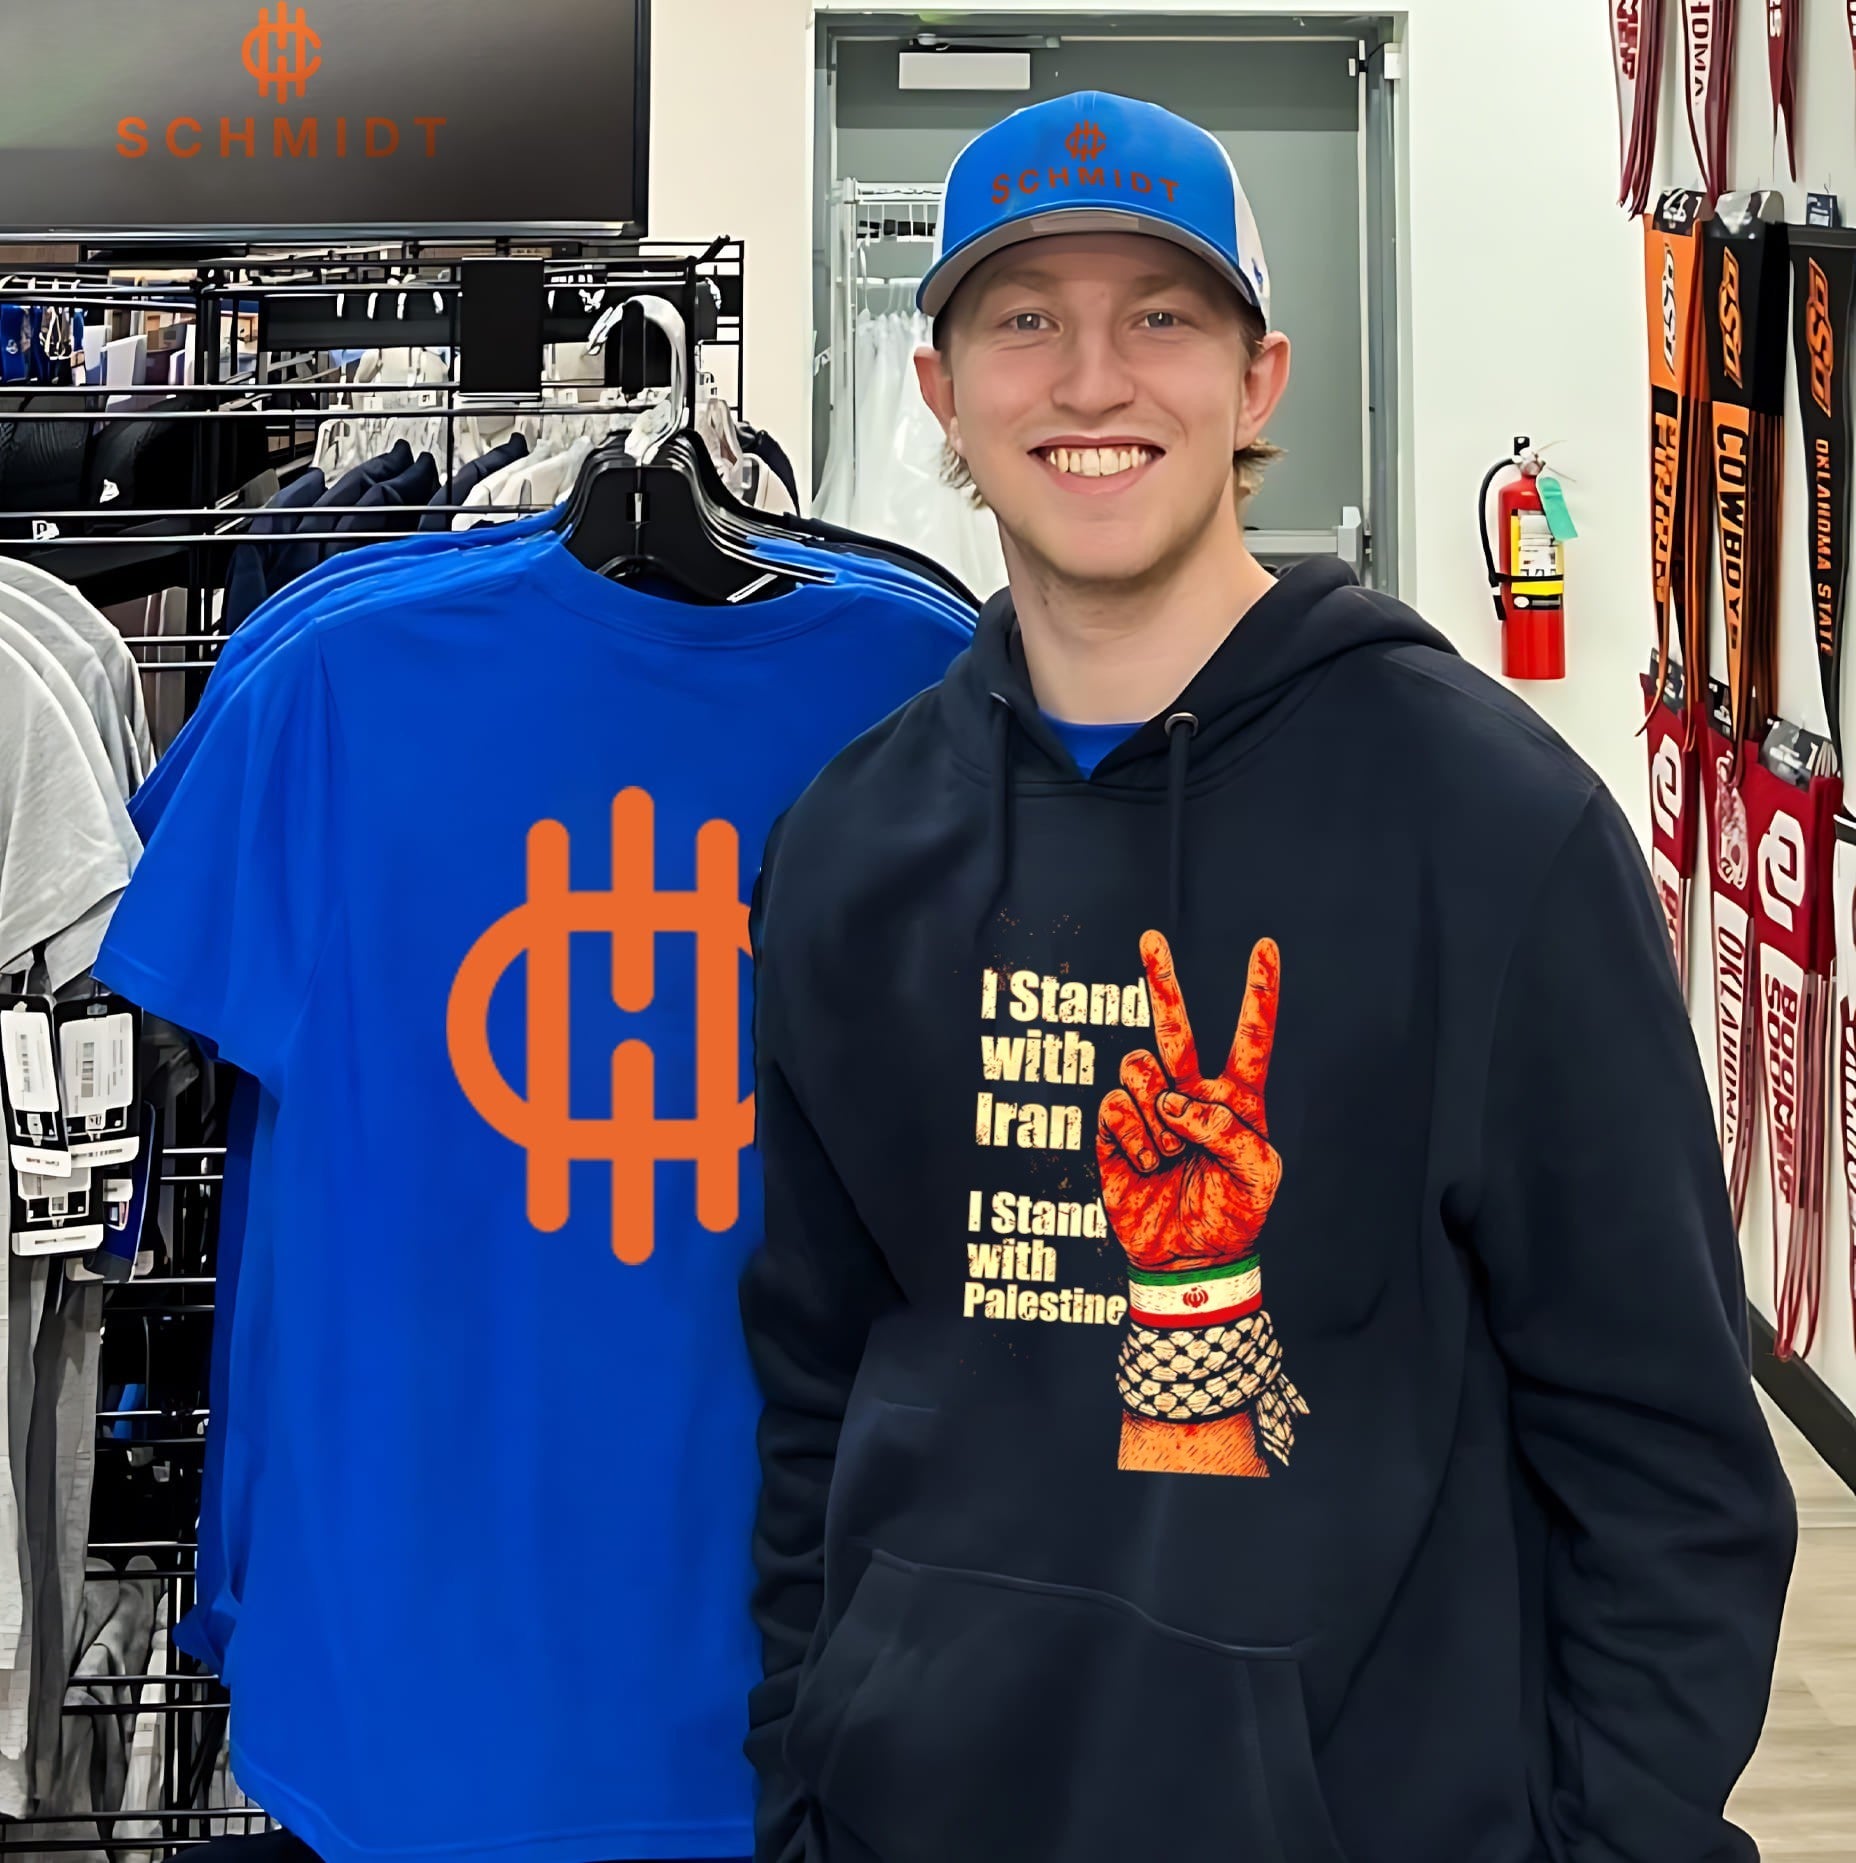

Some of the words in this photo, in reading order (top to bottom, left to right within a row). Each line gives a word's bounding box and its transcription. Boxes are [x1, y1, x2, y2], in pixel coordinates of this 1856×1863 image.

[116, 117, 447, 159] SCHMIDT
[992, 167, 1179, 204] SCHMIDT
[1815, 439, 1833, 570] OKLAHOMA
[981, 969, 999, 1020] I
[1009, 970, 1151, 1028] Stand
[981, 1029, 1096, 1086] with
[975, 1092, 1083, 1151] Iran
[968, 1190, 983, 1232] I
[991, 1191, 1107, 1239] Stand
[966, 1237, 1058, 1282] with
[963, 1281, 1129, 1326] Palestine
